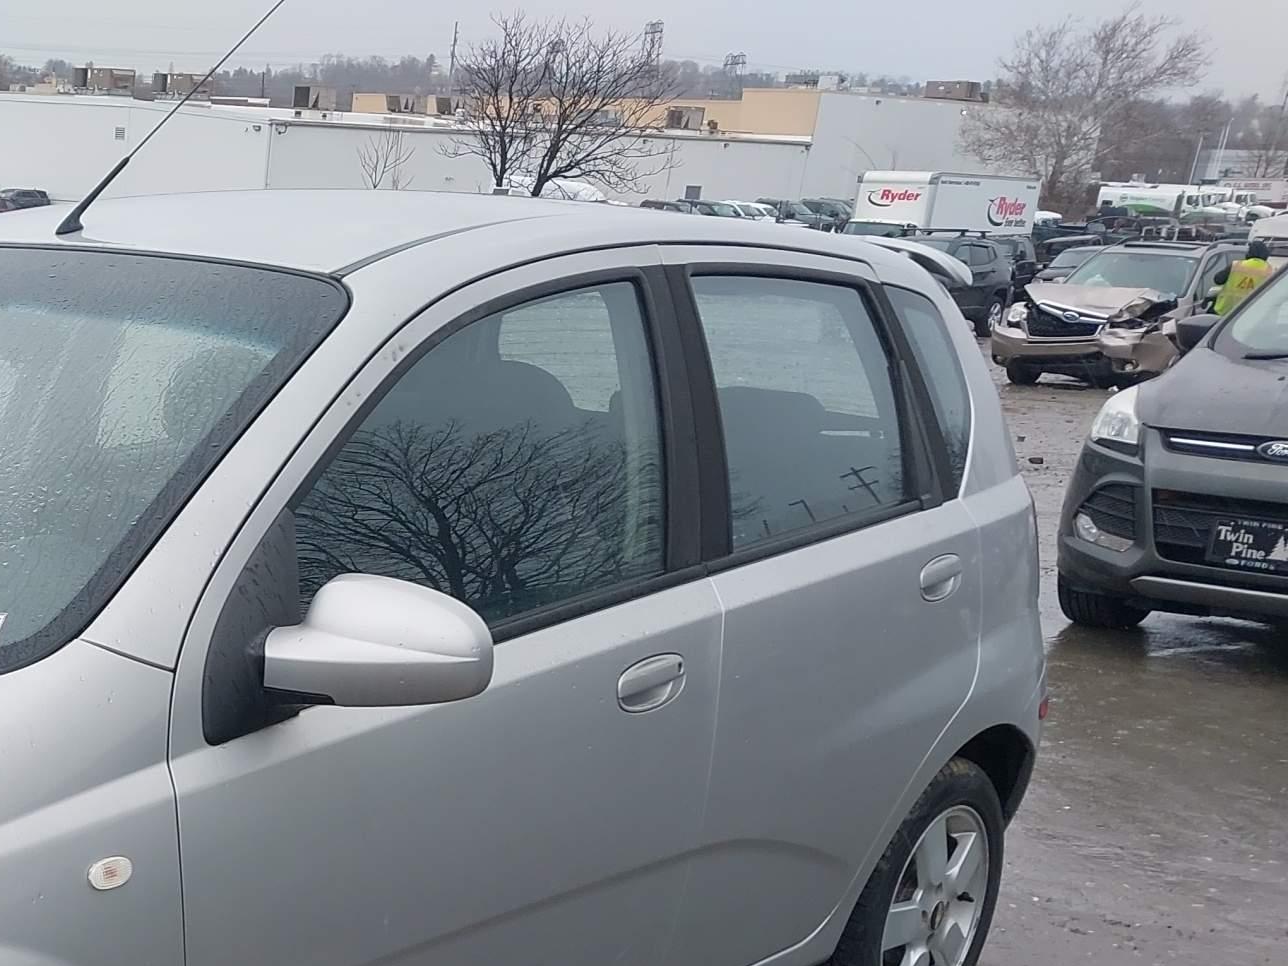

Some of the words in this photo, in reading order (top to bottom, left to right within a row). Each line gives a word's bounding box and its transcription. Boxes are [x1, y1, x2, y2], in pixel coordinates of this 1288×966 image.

[880, 189, 922, 204] Ryder
[996, 196, 1027, 220] Ryder
[1217, 525, 1254, 544] Twin
[1230, 542, 1266, 560] Pine
